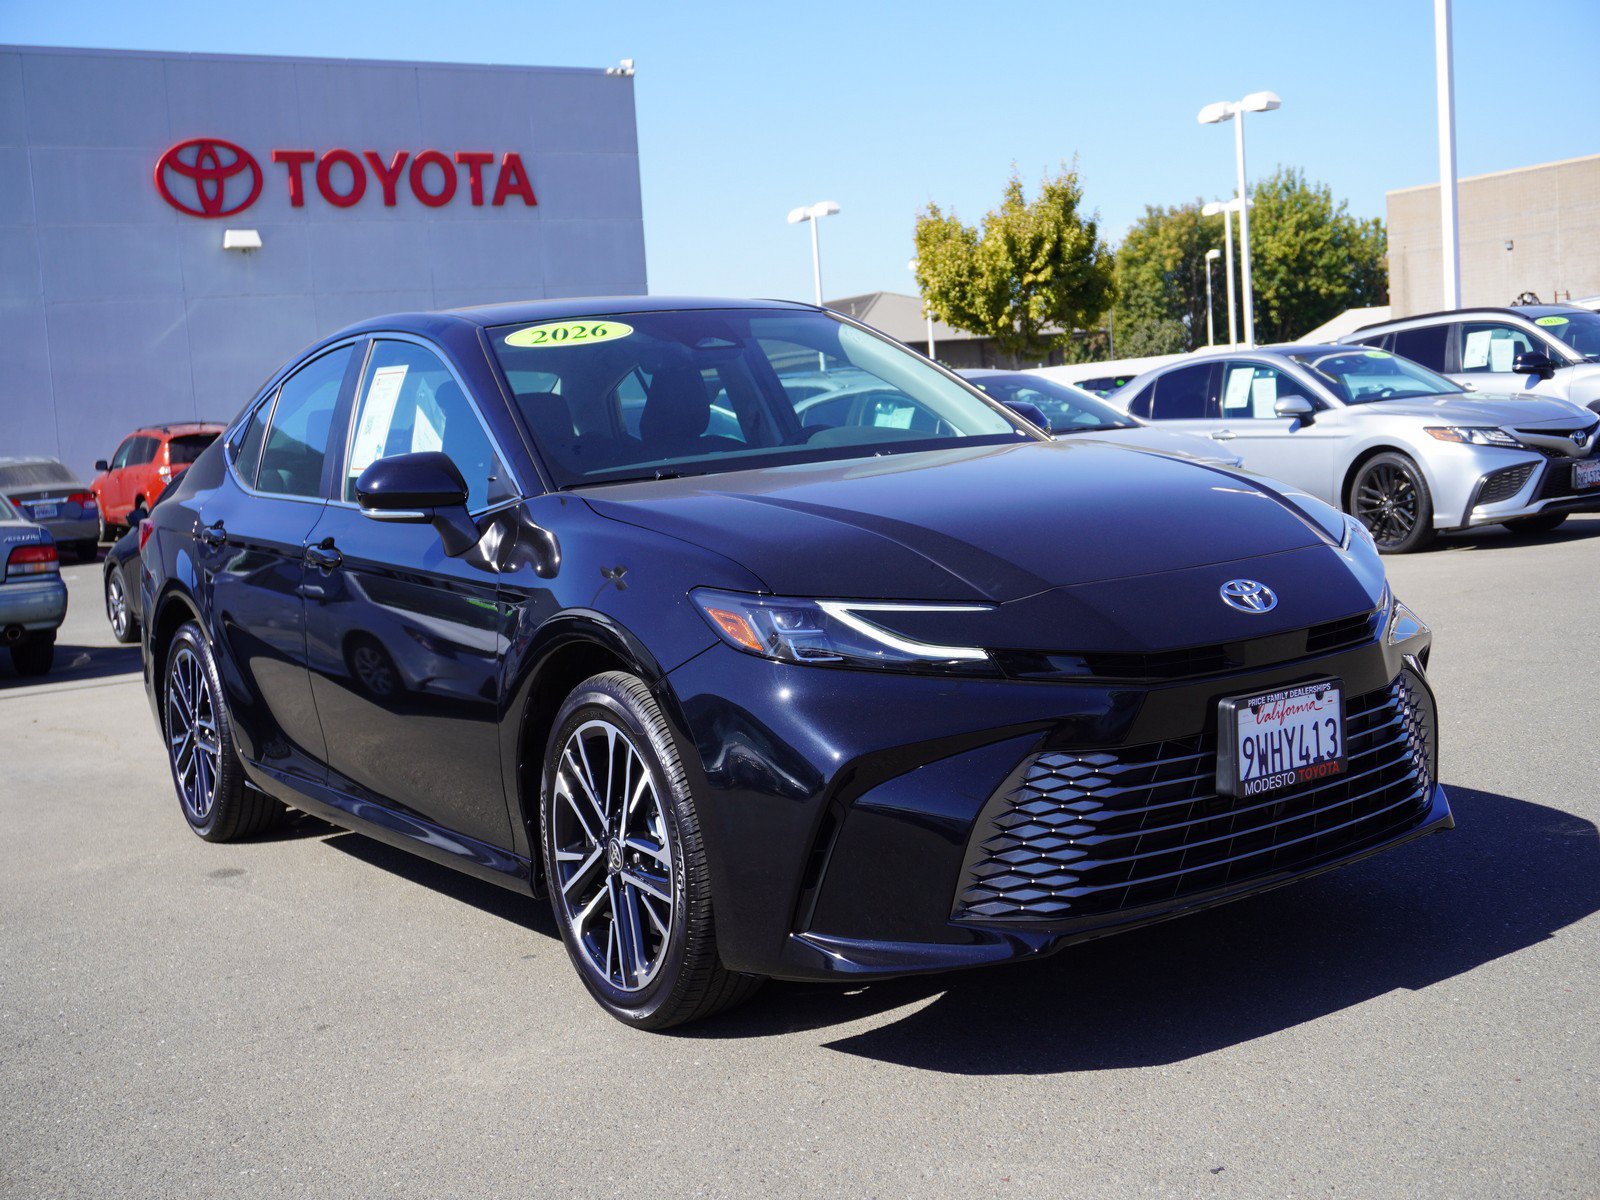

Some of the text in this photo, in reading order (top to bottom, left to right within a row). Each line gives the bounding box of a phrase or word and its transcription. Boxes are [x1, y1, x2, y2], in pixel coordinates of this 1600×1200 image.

[272, 149, 537, 208] TOYOTA
[531, 324, 608, 344] 2026
[1248, 682, 1331, 708] PRICE FAMILY DEALERSHIPS
[1256, 699, 1323, 726] California
[1243, 718, 1337, 781] 9WHY413
[1245, 761, 1340, 796] MODESTO TOYOTA
